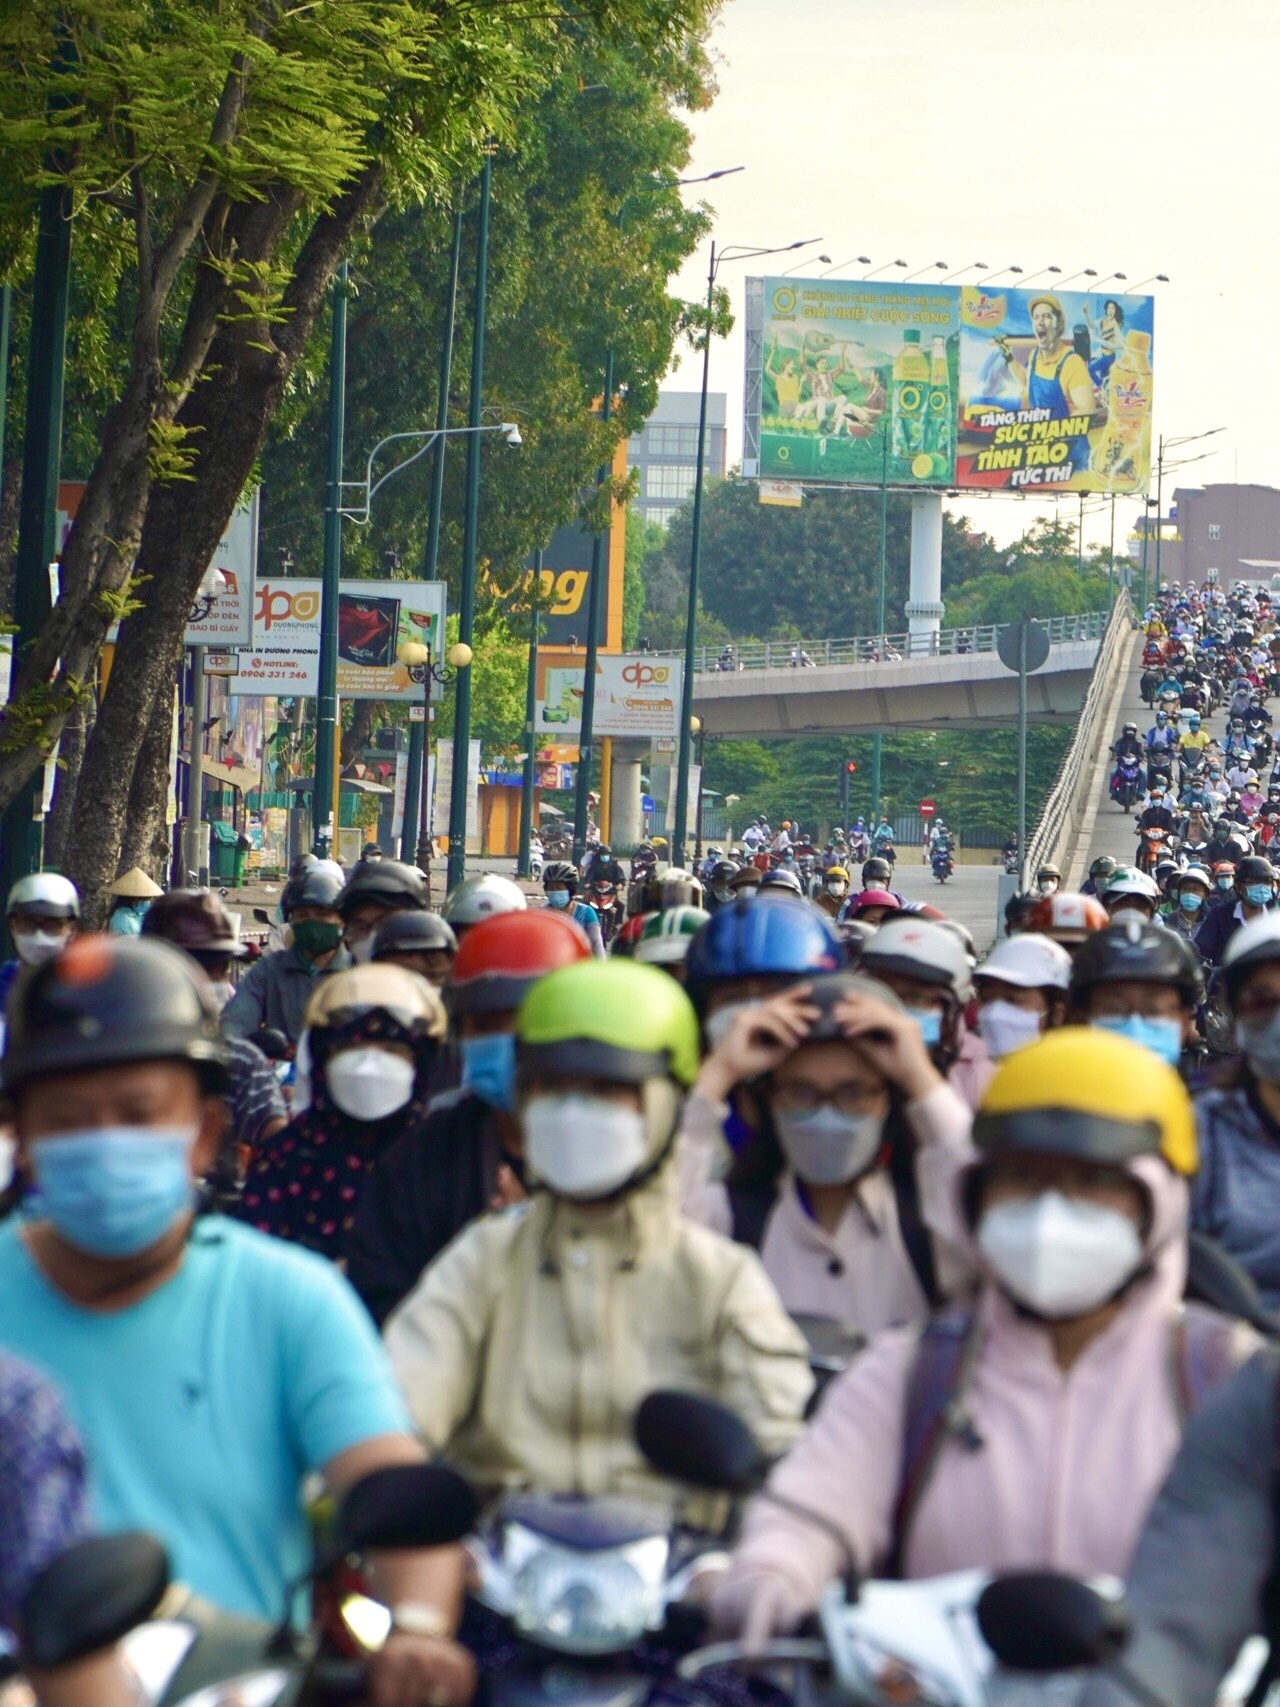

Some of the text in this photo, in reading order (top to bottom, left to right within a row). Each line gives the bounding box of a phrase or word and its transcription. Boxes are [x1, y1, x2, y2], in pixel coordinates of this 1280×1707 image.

[980, 407, 1051, 427] TĂNG THÊM
[994, 416, 1090, 444] SỨC MẠNH
[978, 444, 1022, 471] TỈNH
[1011, 461, 1073, 486] TỨC THÌ
[240, 670, 307, 679] 0906 331 246
